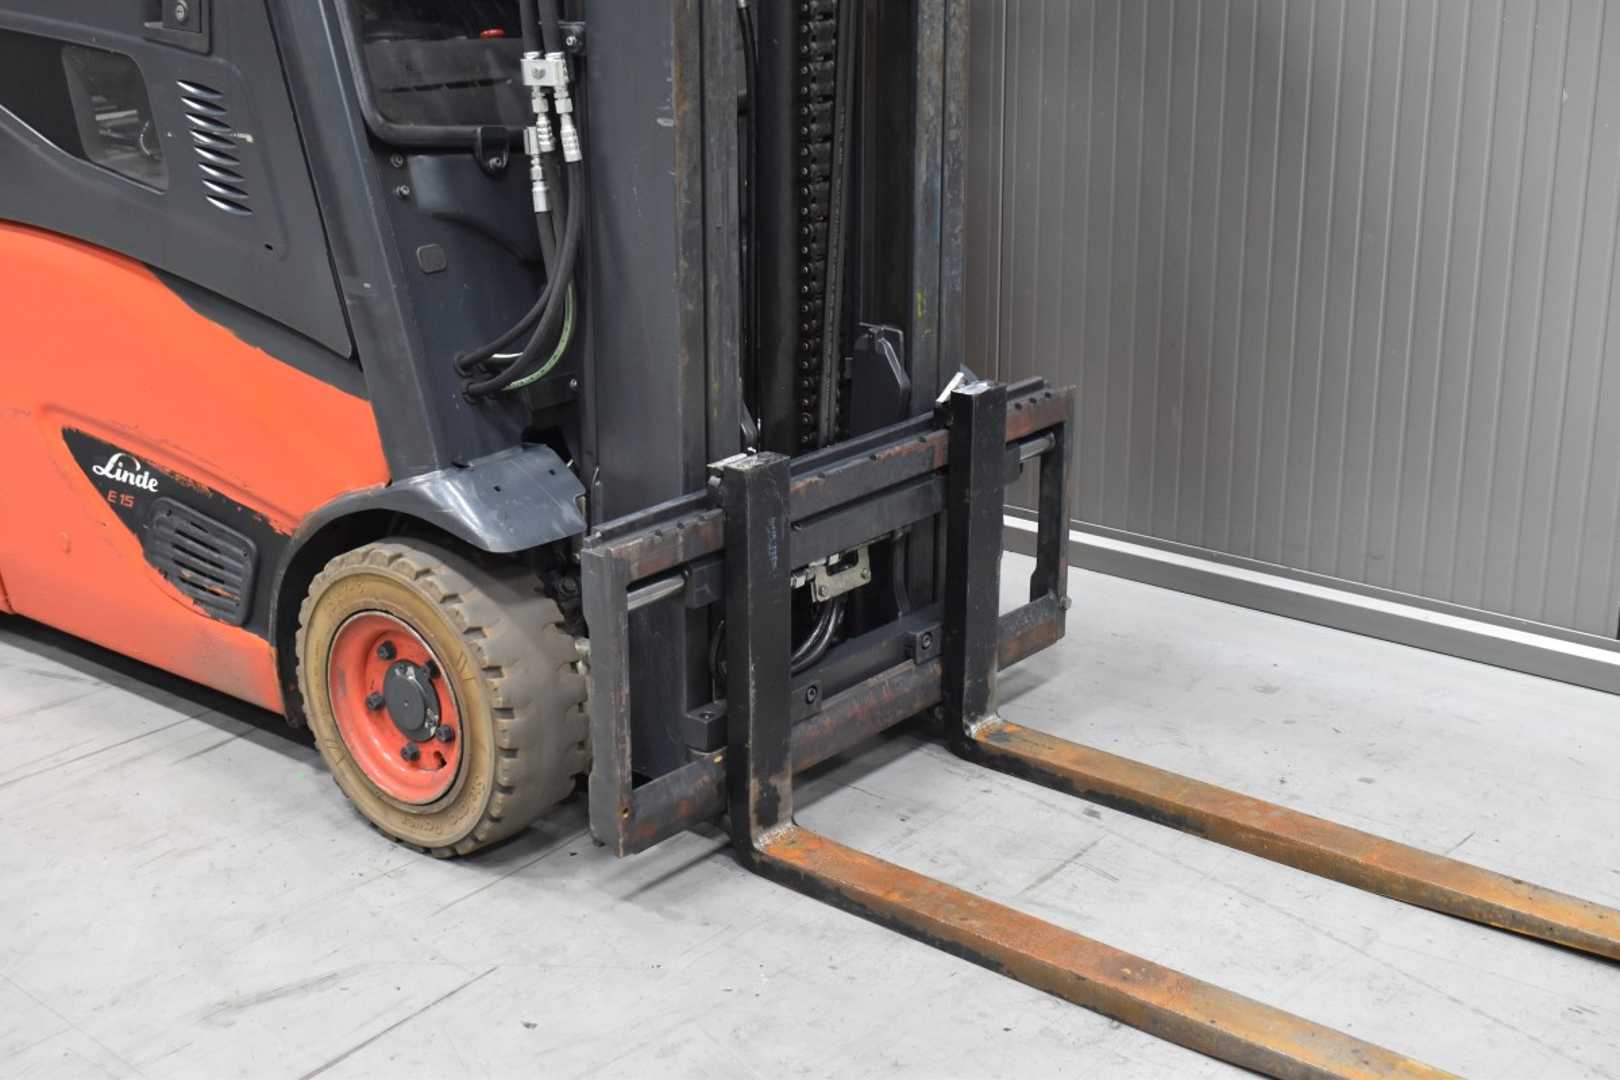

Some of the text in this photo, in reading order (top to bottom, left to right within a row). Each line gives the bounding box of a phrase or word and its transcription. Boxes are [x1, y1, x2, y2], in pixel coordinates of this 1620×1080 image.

[92, 452, 159, 492] Linde
[107, 489, 135, 508] E 15
